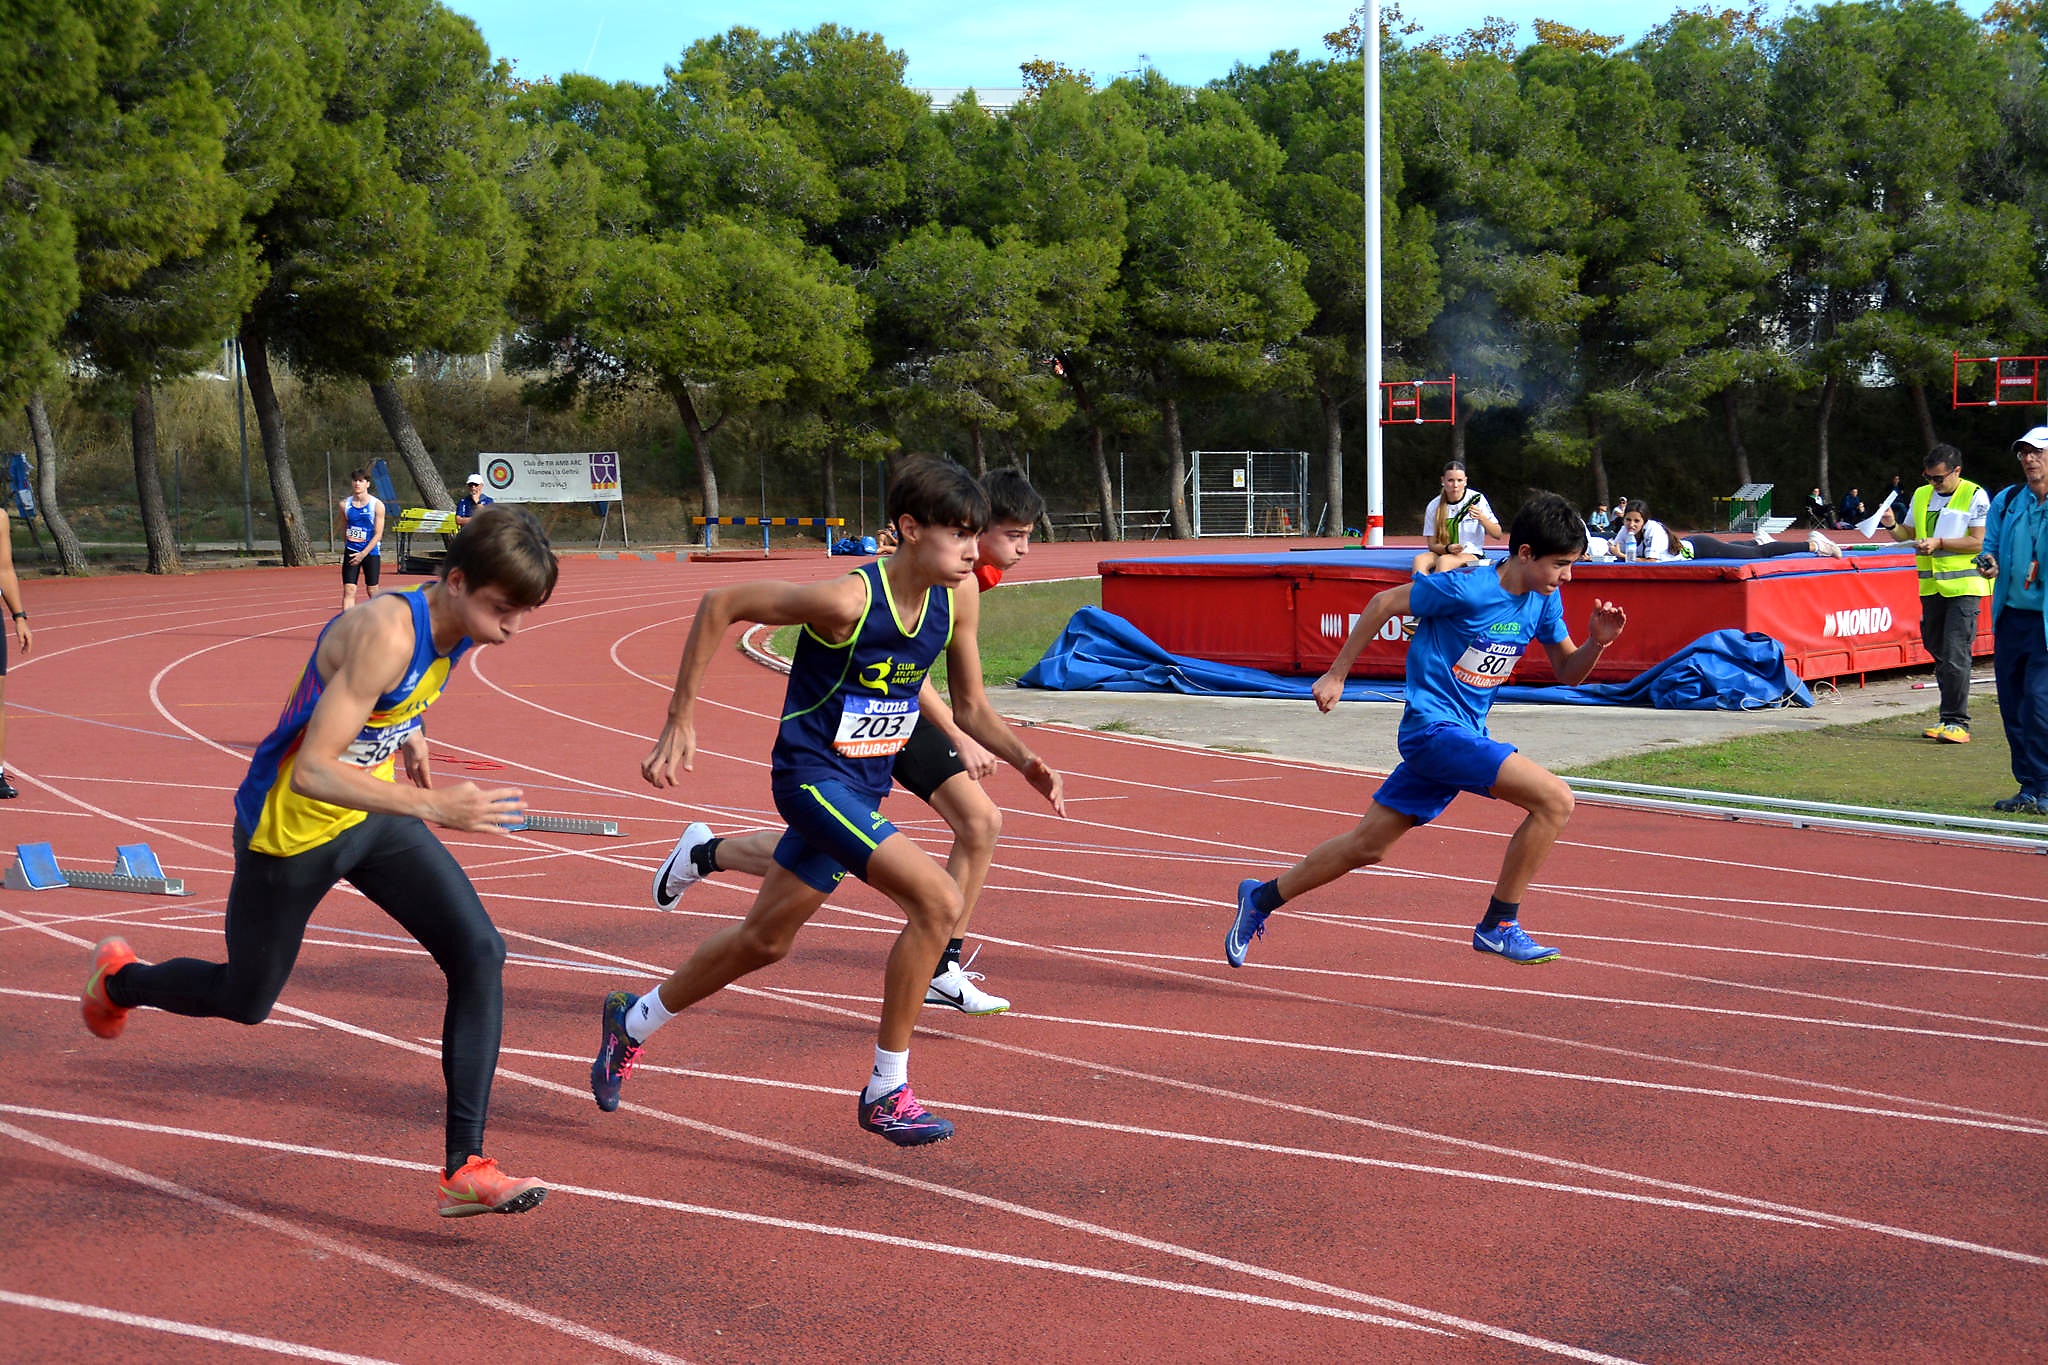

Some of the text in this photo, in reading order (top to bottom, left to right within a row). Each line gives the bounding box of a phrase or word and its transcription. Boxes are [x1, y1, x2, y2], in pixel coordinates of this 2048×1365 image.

[1836, 607, 1892, 637] MONDO
[897, 662, 916, 671] CLUB
[1477, 655, 1507, 675] 80
[890, 676, 911, 685] SANT
[850, 715, 906, 740] 203
